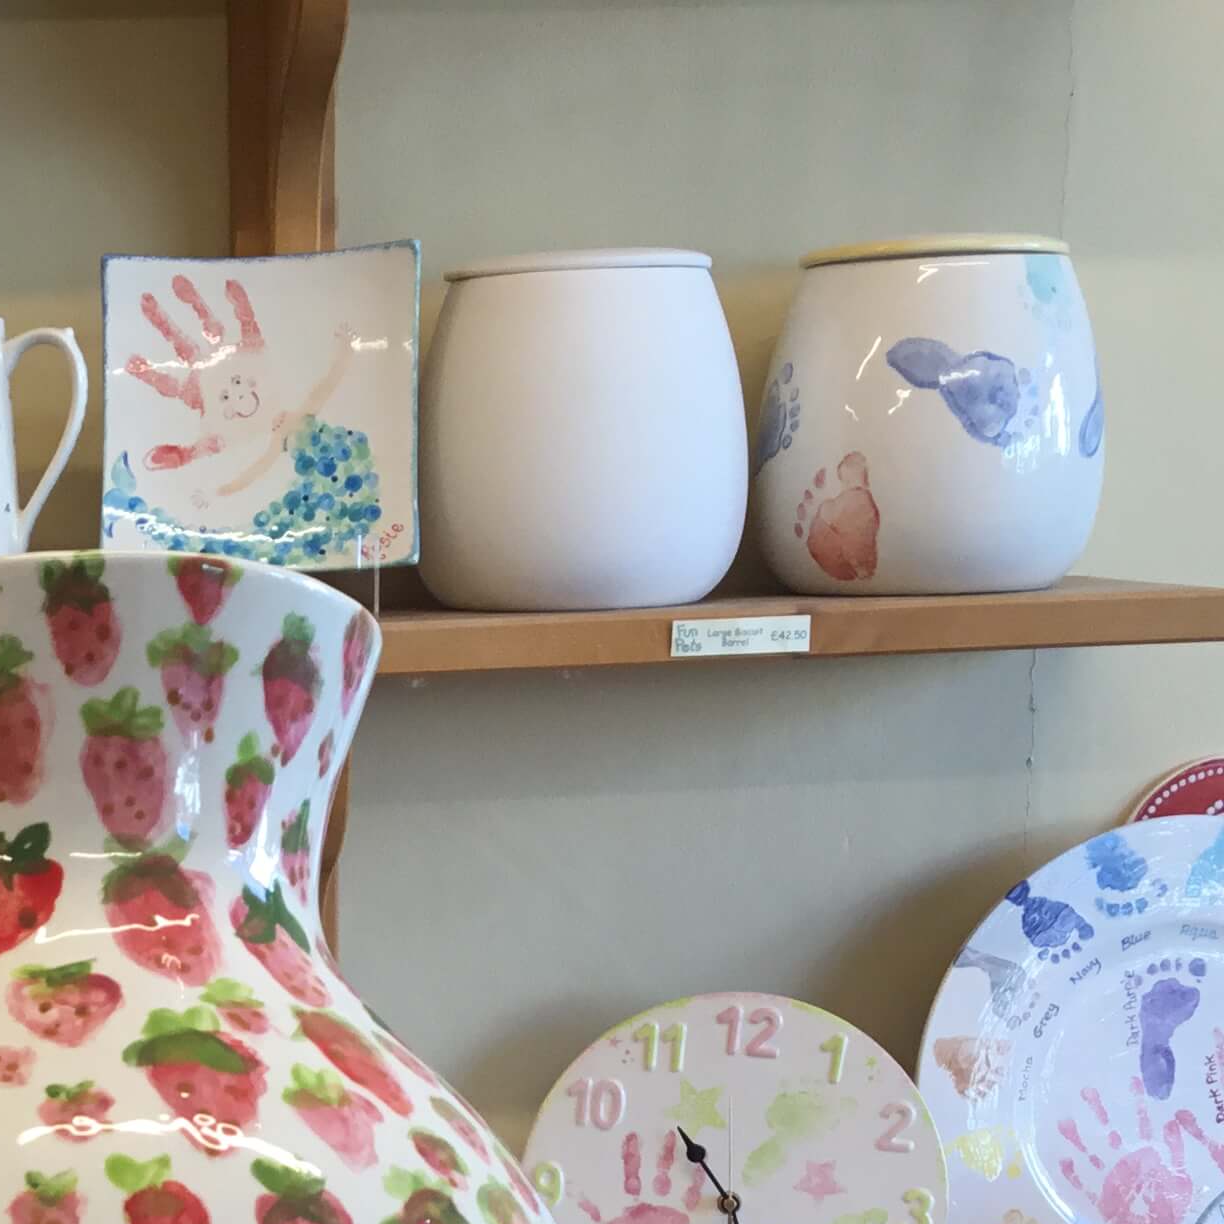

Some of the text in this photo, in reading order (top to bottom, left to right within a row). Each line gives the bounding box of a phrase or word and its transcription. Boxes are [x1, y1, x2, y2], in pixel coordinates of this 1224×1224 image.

[676, 638, 702, 653] Pots
[677, 624, 698, 638] Fun
[707, 628, 731, 638] Large
[721, 637, 749, 647] Barrel
[771, 630, 808, 641] £42.50
[1121, 930, 1151, 951] Blue
[1180, 925, 1218, 941] Aqua
[1069, 957, 1102, 985] Navy
[716, 1004, 783, 1059] 12
[1033, 1003, 1060, 1039] Grey
[1126, 1014, 1142, 1047] Dark
[633, 1022, 686, 1074] 11
[819, 1032, 849, 1085] 1
[1018, 1056, 1033, 1102] Mocha
[1204, 1054, 1224, 1124] Dark Pink
[567, 1077, 626, 1131] 10
[874, 1101, 917, 1153] 2
[533, 1161, 564, 1208] 9
